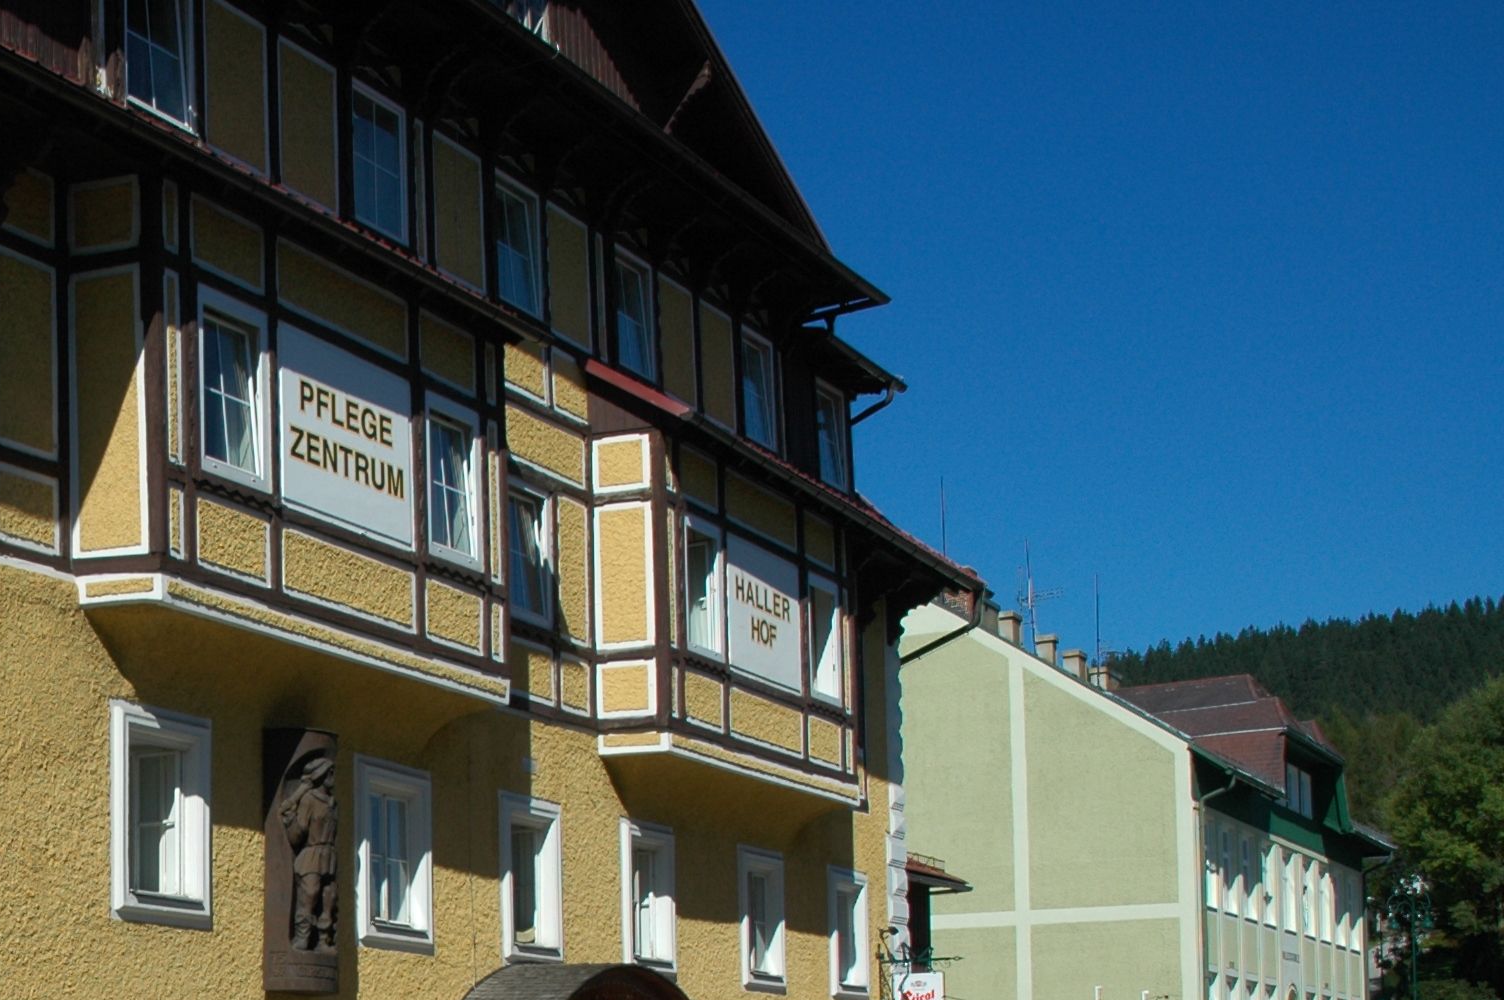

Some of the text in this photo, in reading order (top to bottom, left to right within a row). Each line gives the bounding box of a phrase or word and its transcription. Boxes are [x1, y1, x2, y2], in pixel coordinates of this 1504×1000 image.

[299, 380, 393, 448] PFLEGE
[289, 426, 405, 499] ZENTRUM
[735, 575, 791, 622] HALLER
[751, 616, 777, 647] HOF
